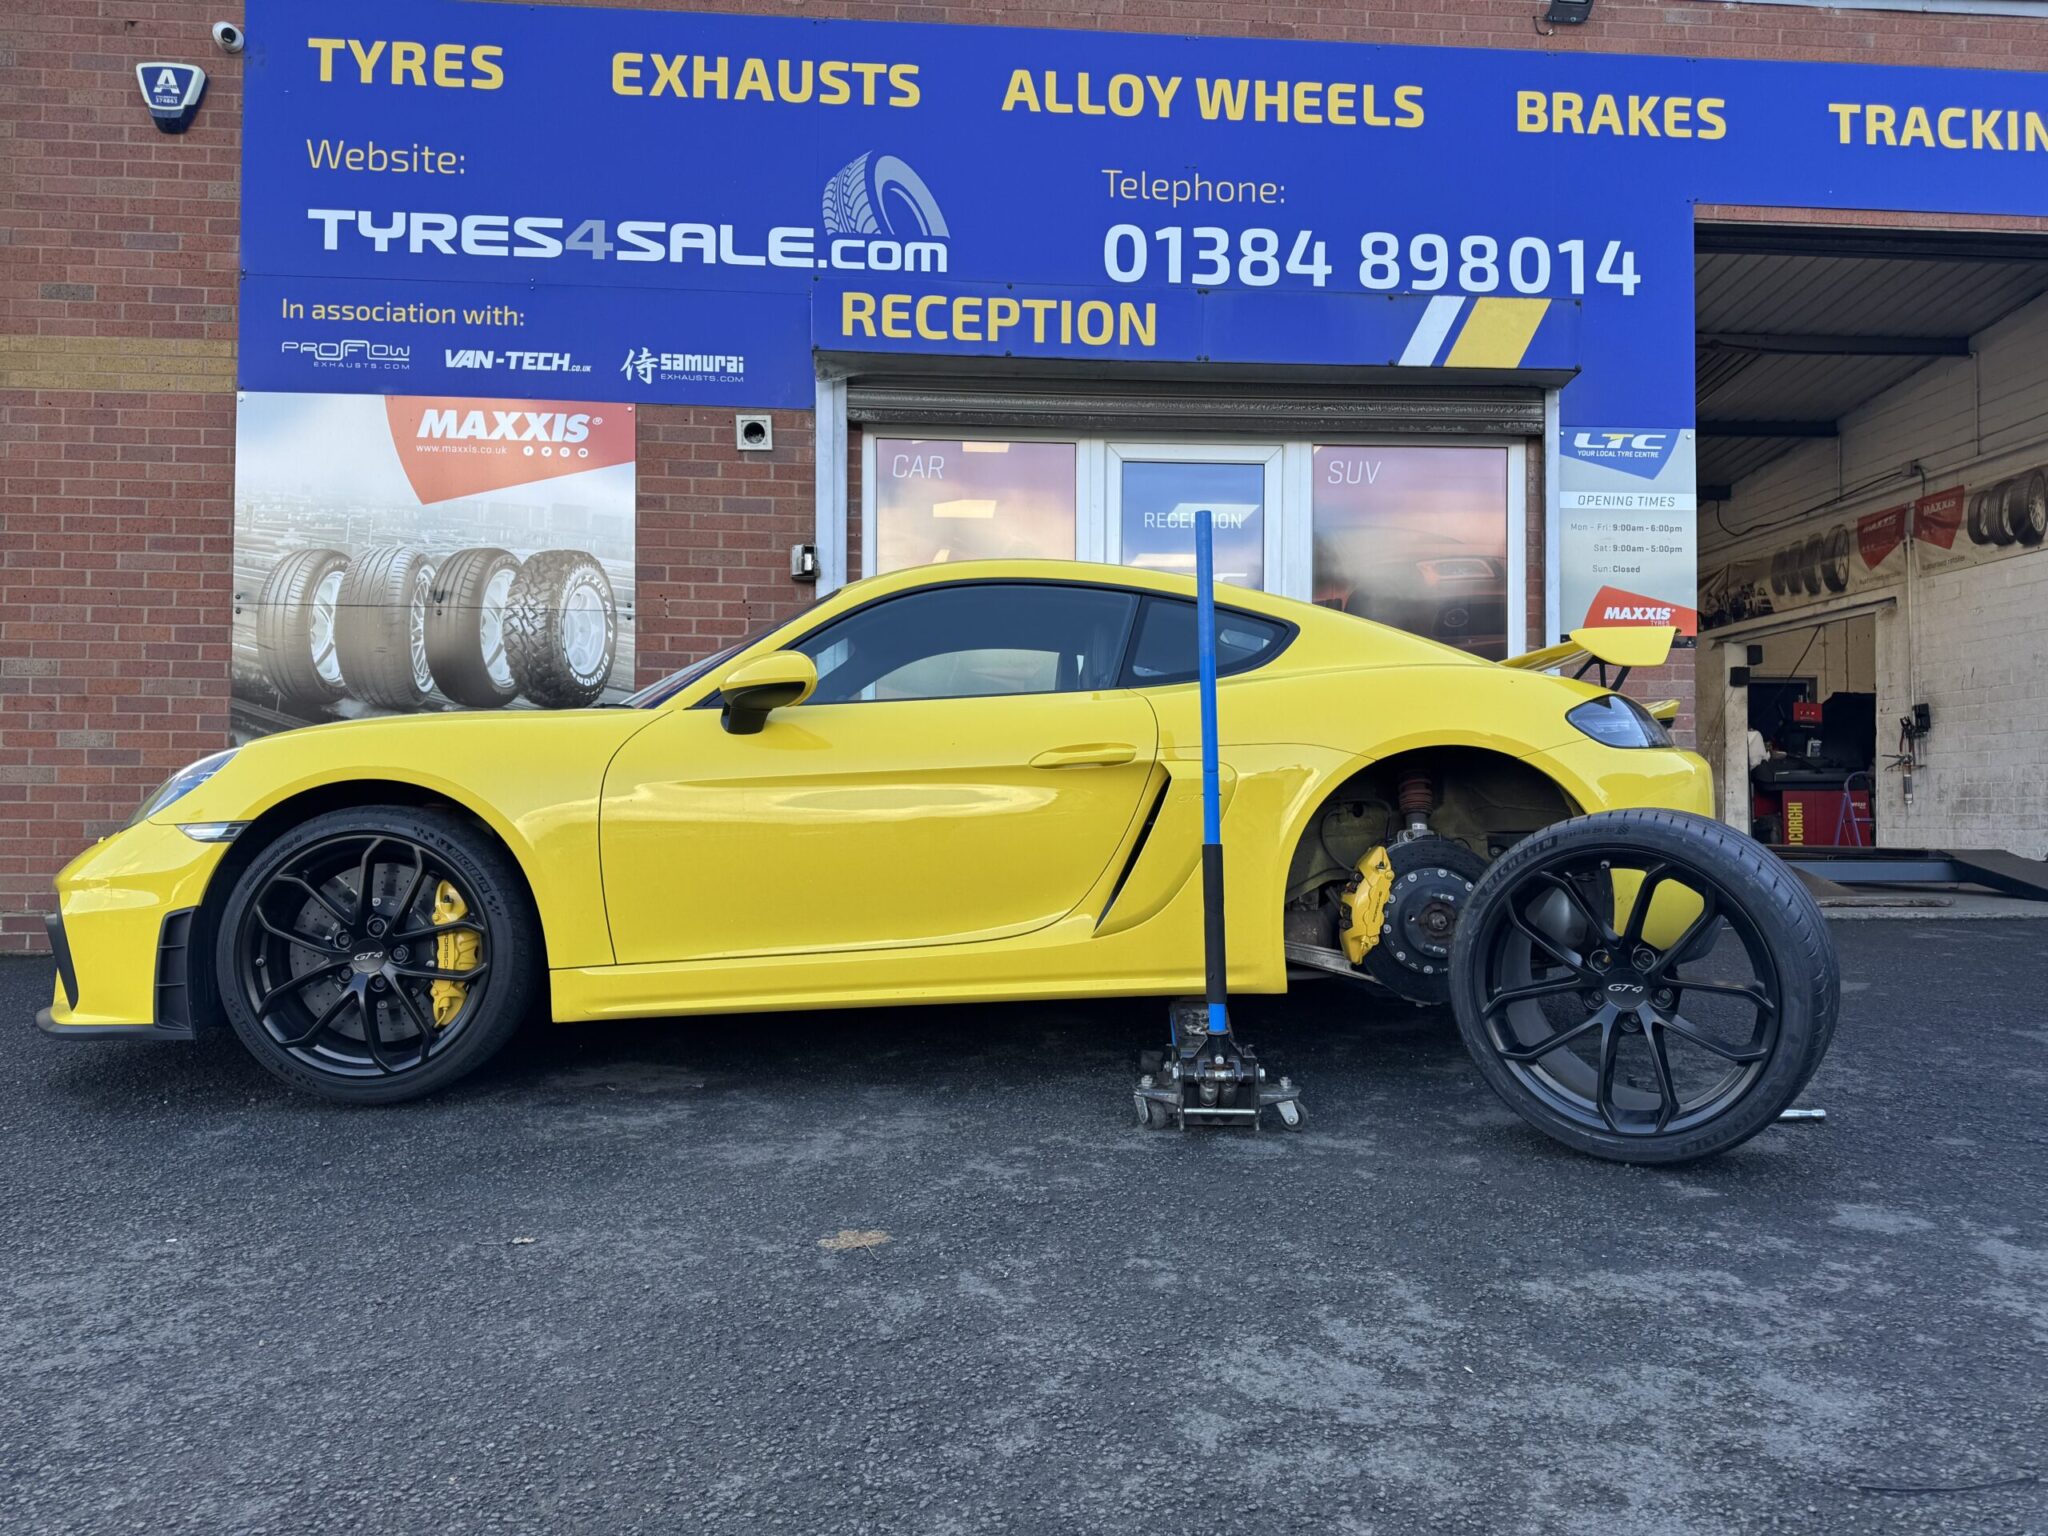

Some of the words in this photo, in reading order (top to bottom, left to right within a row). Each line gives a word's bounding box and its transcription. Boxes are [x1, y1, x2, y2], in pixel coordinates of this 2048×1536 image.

[308, 38, 504, 90] TYRES
[612, 52, 921, 108] EXHAUSTS
[1002, 69, 1182, 118] ALLOY
[1195, 77, 1425, 128] WHEELS
[1517, 90, 1727, 140] BRAKES
[306, 138, 465, 174] Website:
[1102, 169, 1285, 208] Telephone:
[307, 208, 950, 273] TYRES4SALE.com
[1104, 223, 1333, 288] 01384
[1360, 231, 1641, 297] 898014
[282, 299, 304, 318] In
[312, 302, 456, 323] association
[462, 305, 525, 326] with:
[841, 291, 1157, 347] RECEPTION
[313, 361, 410, 370] EXHAUSTS.COM
[660, 373, 744, 383] EXHAUSTS.COM
[416, 444, 508, 455] www.maxxis.co.uk
[1574, 433, 1667, 449] LTC
[892, 454, 946, 480] CAR
[1327, 460, 1382, 485] SUV
[1577, 494, 1633, 507] OPENING
[1638, 495, 1676, 508] TIMES
[1144, 512, 1242, 529] RECEION
[1570, 523, 1588, 531] Mon
[1612, 523, 1644, 532] 9:00am
[1650, 524, 1683, 533] 6:00pm
[1612, 544, 1644, 552] 9:00am
[1650, 544, 1683, 554] 5:00pm
[1612, 564, 1641, 573] Closed
[1604, 607, 1672, 620] MAXXIS
[1787, 802, 1804, 842] CORGHI
[1484, 835, 1555, 893] MICHELIN
[354, 951, 383, 961] GT4
[1607, 983, 1644, 994] GT4
